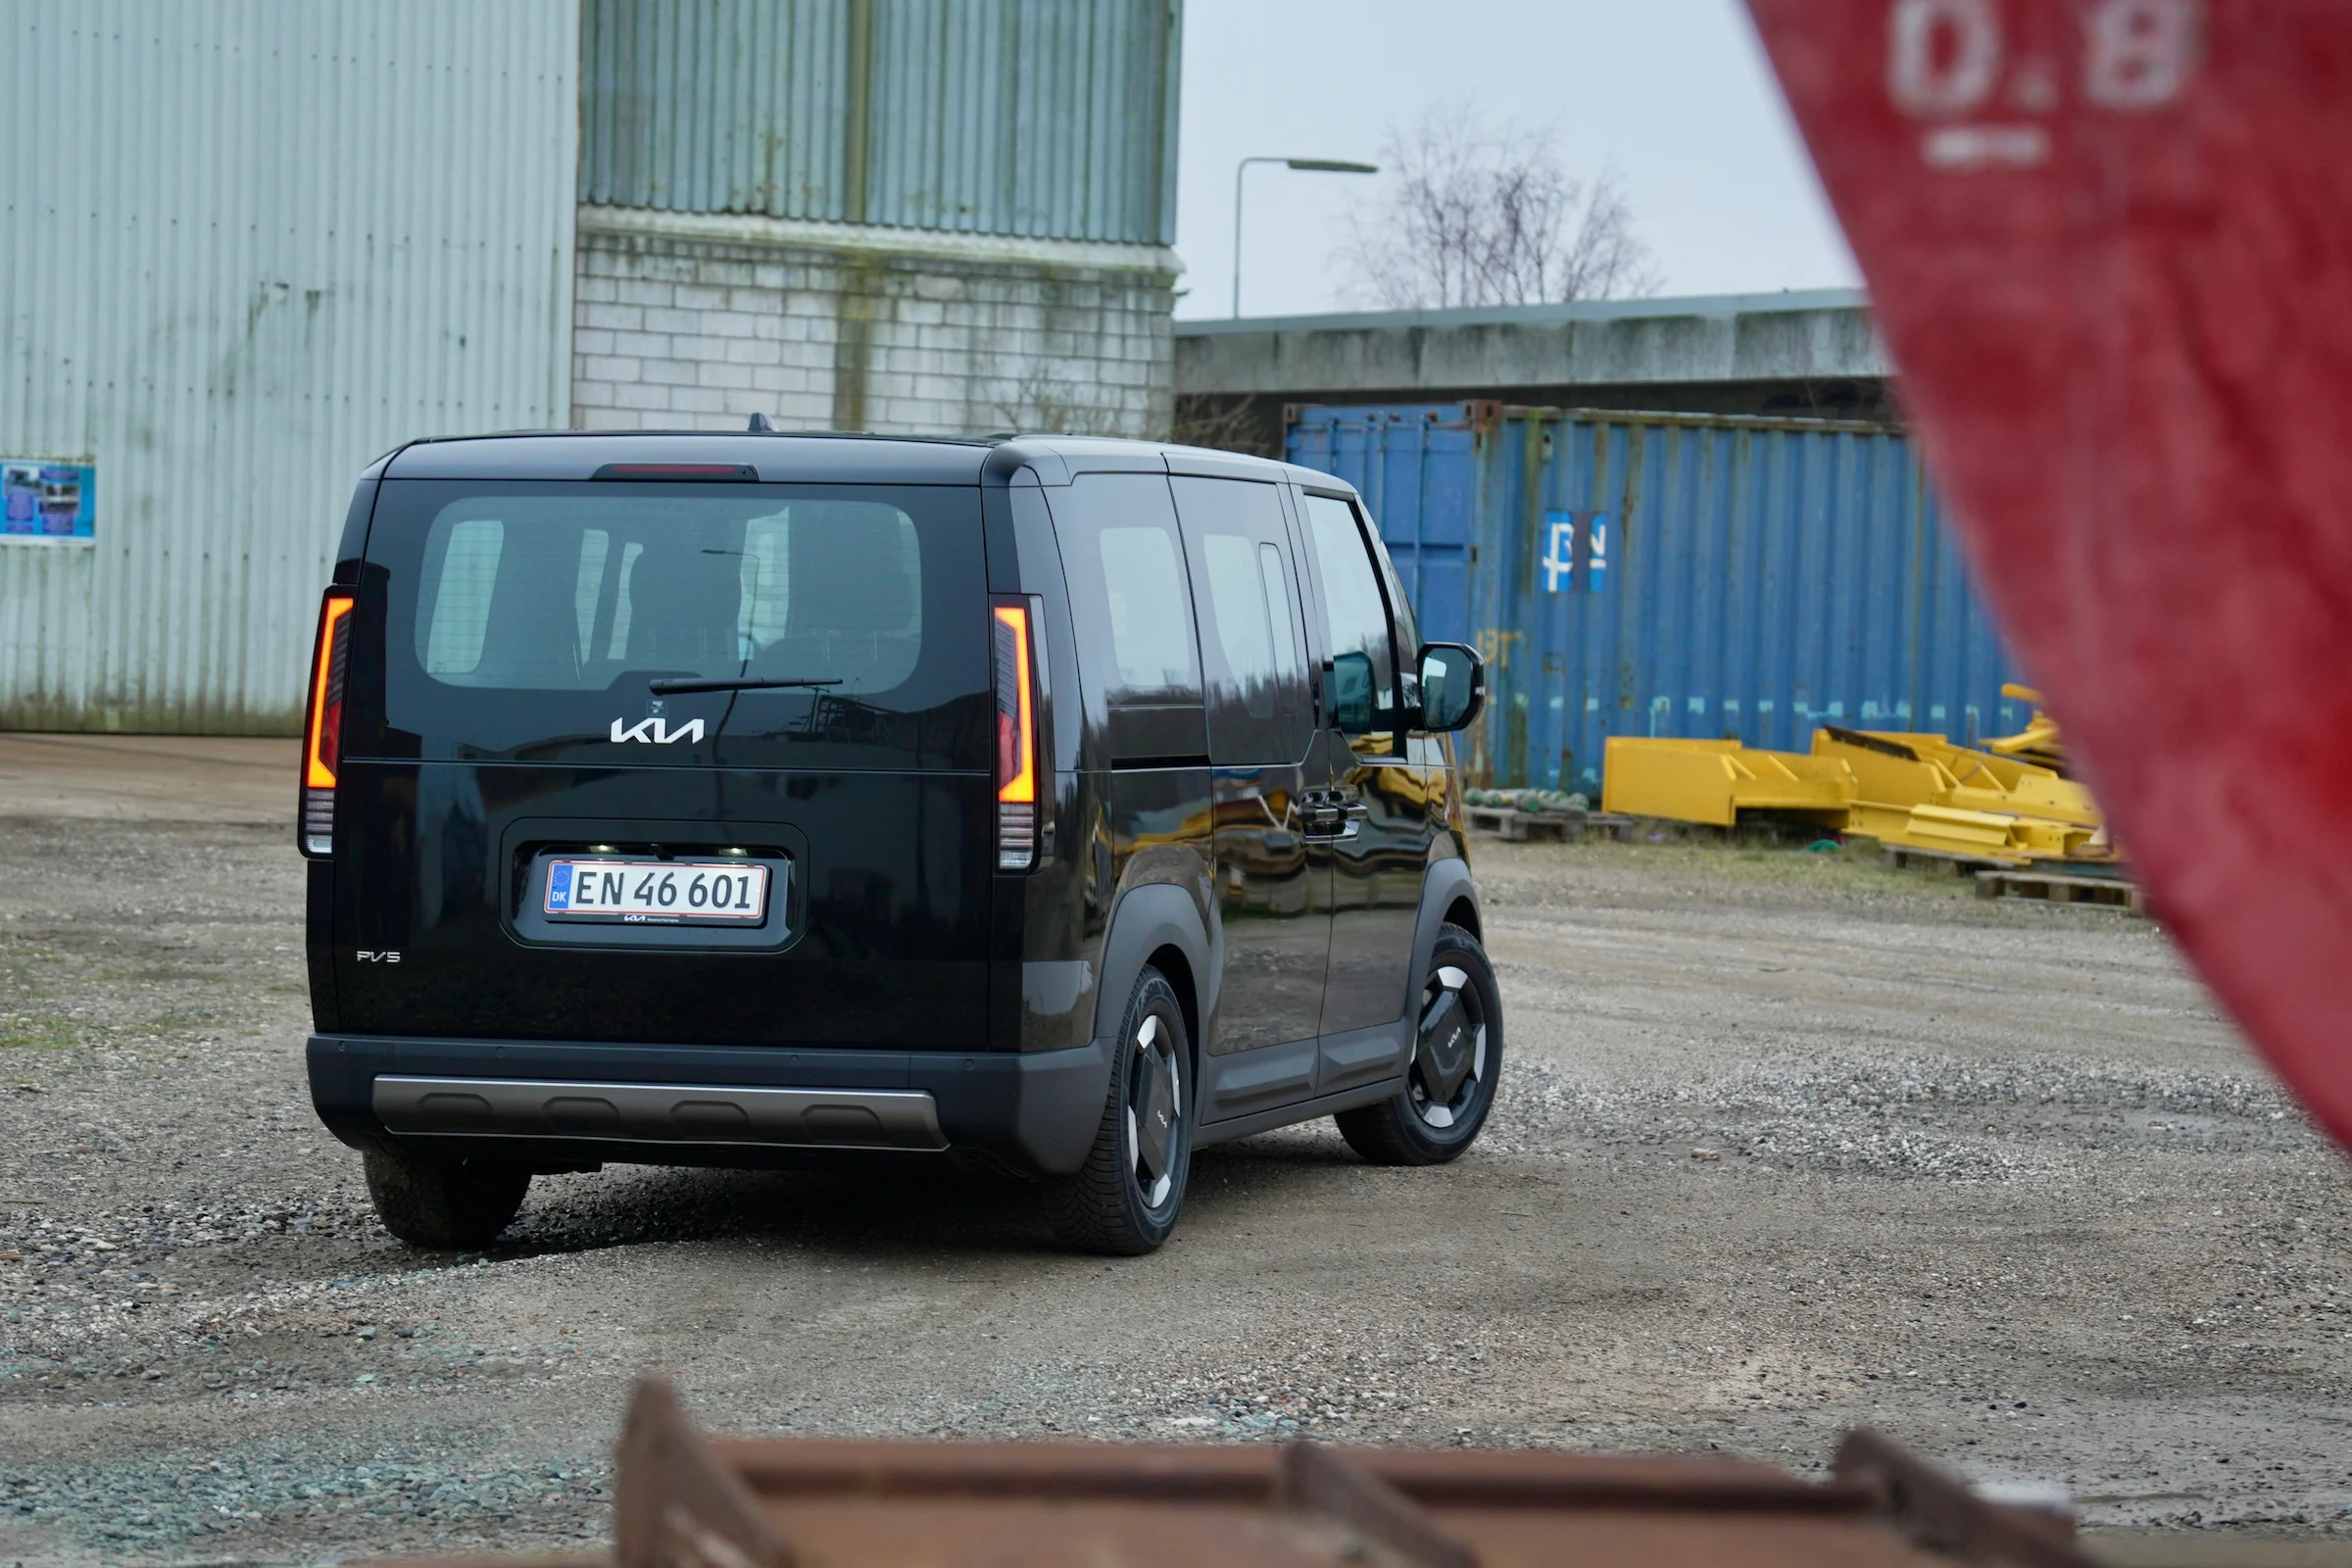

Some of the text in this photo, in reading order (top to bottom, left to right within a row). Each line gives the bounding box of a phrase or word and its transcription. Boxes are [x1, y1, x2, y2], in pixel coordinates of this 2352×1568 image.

[611, 716, 705, 744] KIA
[552, 891, 566, 903] DK
[575, 871, 751, 909] EN 46 601
